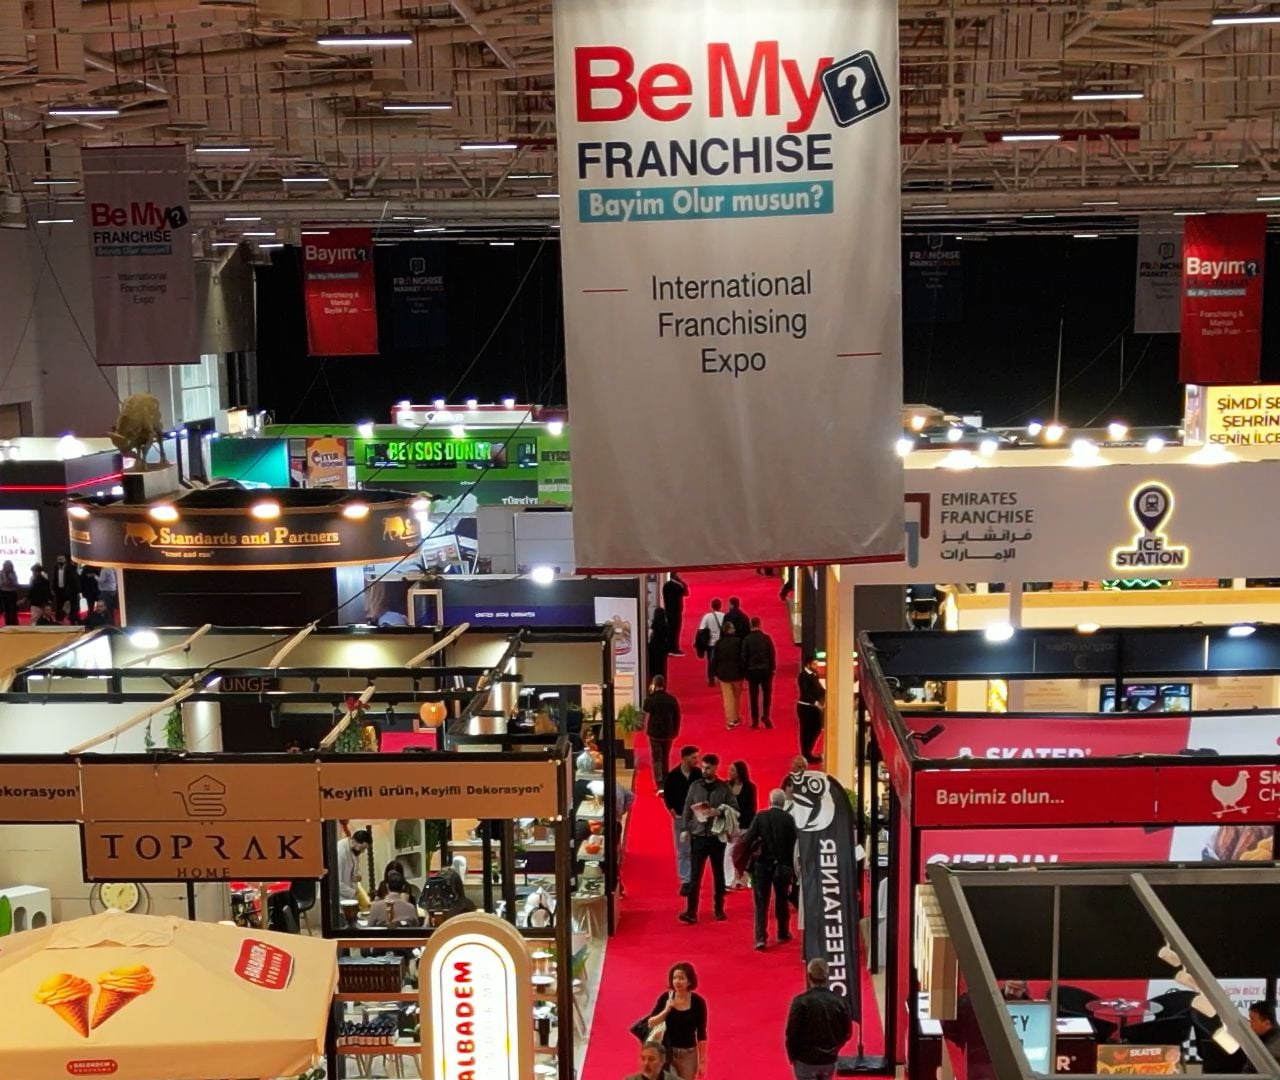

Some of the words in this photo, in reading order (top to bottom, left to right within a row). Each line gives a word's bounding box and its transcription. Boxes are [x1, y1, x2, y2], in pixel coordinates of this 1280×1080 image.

[574, 46, 693, 122] Be
[707, 40, 834, 133] My
[578, 133, 833, 179] FRANCHISE
[589, 190, 664, 222] Bayim
[673, 187, 723, 213] Olur
[731, 184, 824, 211] musun?
[91, 203, 127, 227] Be
[94, 230, 172, 244] FRANCHISE
[652, 269, 811, 300] International
[658, 308, 807, 339] Franchising
[701, 347, 766, 377] Expo
[1217, 395, 1262, 413] ŞİMDİ
[1210, 431, 1250, 445] SENİN
[941, 492, 1017, 506] EMIRATES
[941, 509, 1034, 525] FRANCHISE
[160, 527, 237, 545] Standards
[241, 531, 270, 545] and
[274, 527, 339, 544] Partners
[1138, 539, 1162, 551] ICE
[1117, 551, 1184, 565] STATION
[421, 786, 461, 797] Keyifli
[936, 789, 1006, 809] Bayimiz
[1011, 790, 1065, 805] olun...
[101, 834, 303, 860] TOPRAK
[177, 867, 231, 878] HOME
